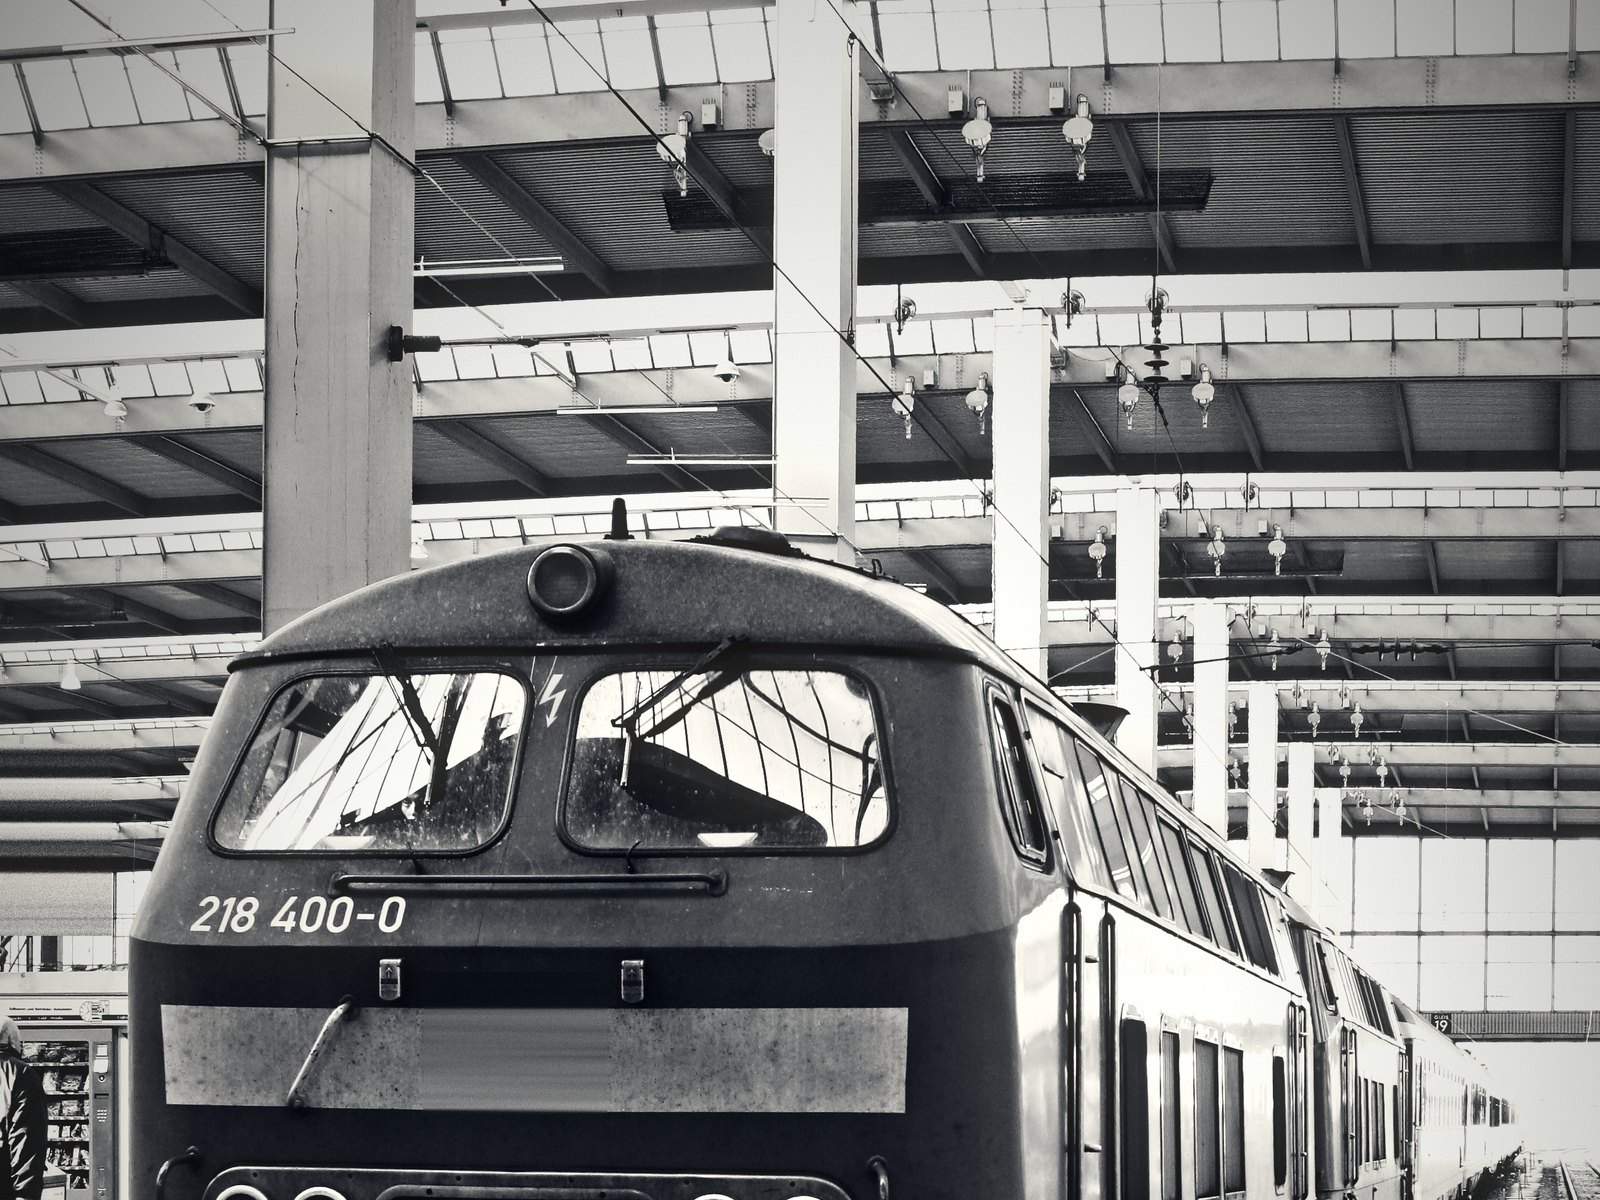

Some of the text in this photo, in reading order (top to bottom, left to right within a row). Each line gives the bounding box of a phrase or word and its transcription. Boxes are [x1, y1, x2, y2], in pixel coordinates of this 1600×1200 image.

[190, 896, 406, 934] 218 400-0
[1434, 1019, 1448, 1032] 19
